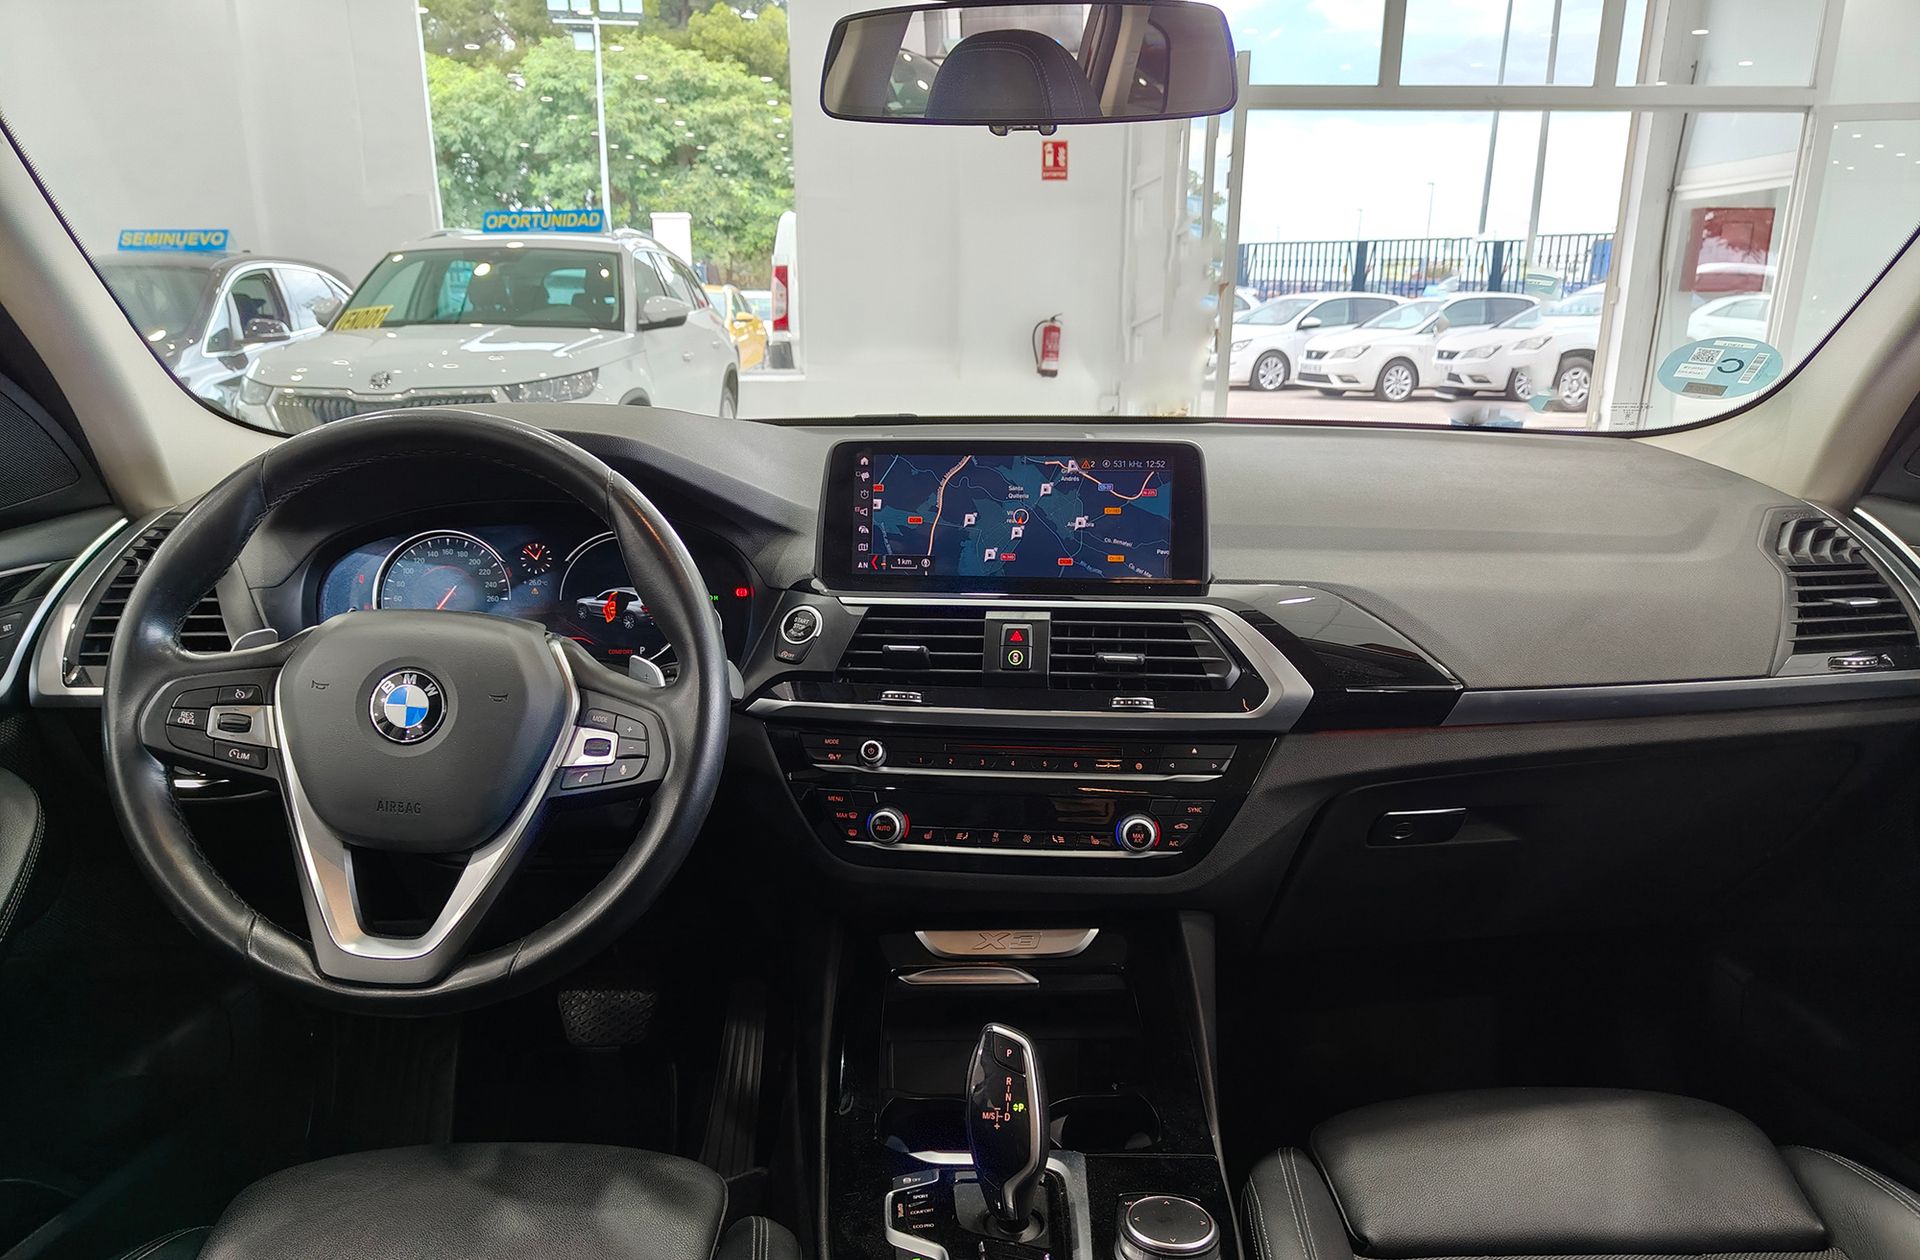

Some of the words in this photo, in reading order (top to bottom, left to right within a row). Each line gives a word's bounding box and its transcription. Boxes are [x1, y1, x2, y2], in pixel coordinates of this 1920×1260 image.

[486, 212, 600, 229] OPORTUNIDAD
[121, 231, 225, 246] SEMINUEVO
[2, 623, 12, 632] SET
[639, 646, 646, 654] P
[381, 673, 439, 698] BMW
[177, 716, 196, 726] CNCL
[592, 715, 608, 723] MODE
[236, 752, 251, 761] LIM
[376, 800, 422, 814] AIRBAG
[971, 931, 1041, 951] X3
[1006, 1049, 1013, 1057] P
[1006, 1077, 1012, 1085] R
[1005, 1093, 1012, 1101] N
[1018, 1103, 1025, 1113] P
[982, 1111, 995, 1120] M/S
[1004, 1112, 1011, 1121] D
